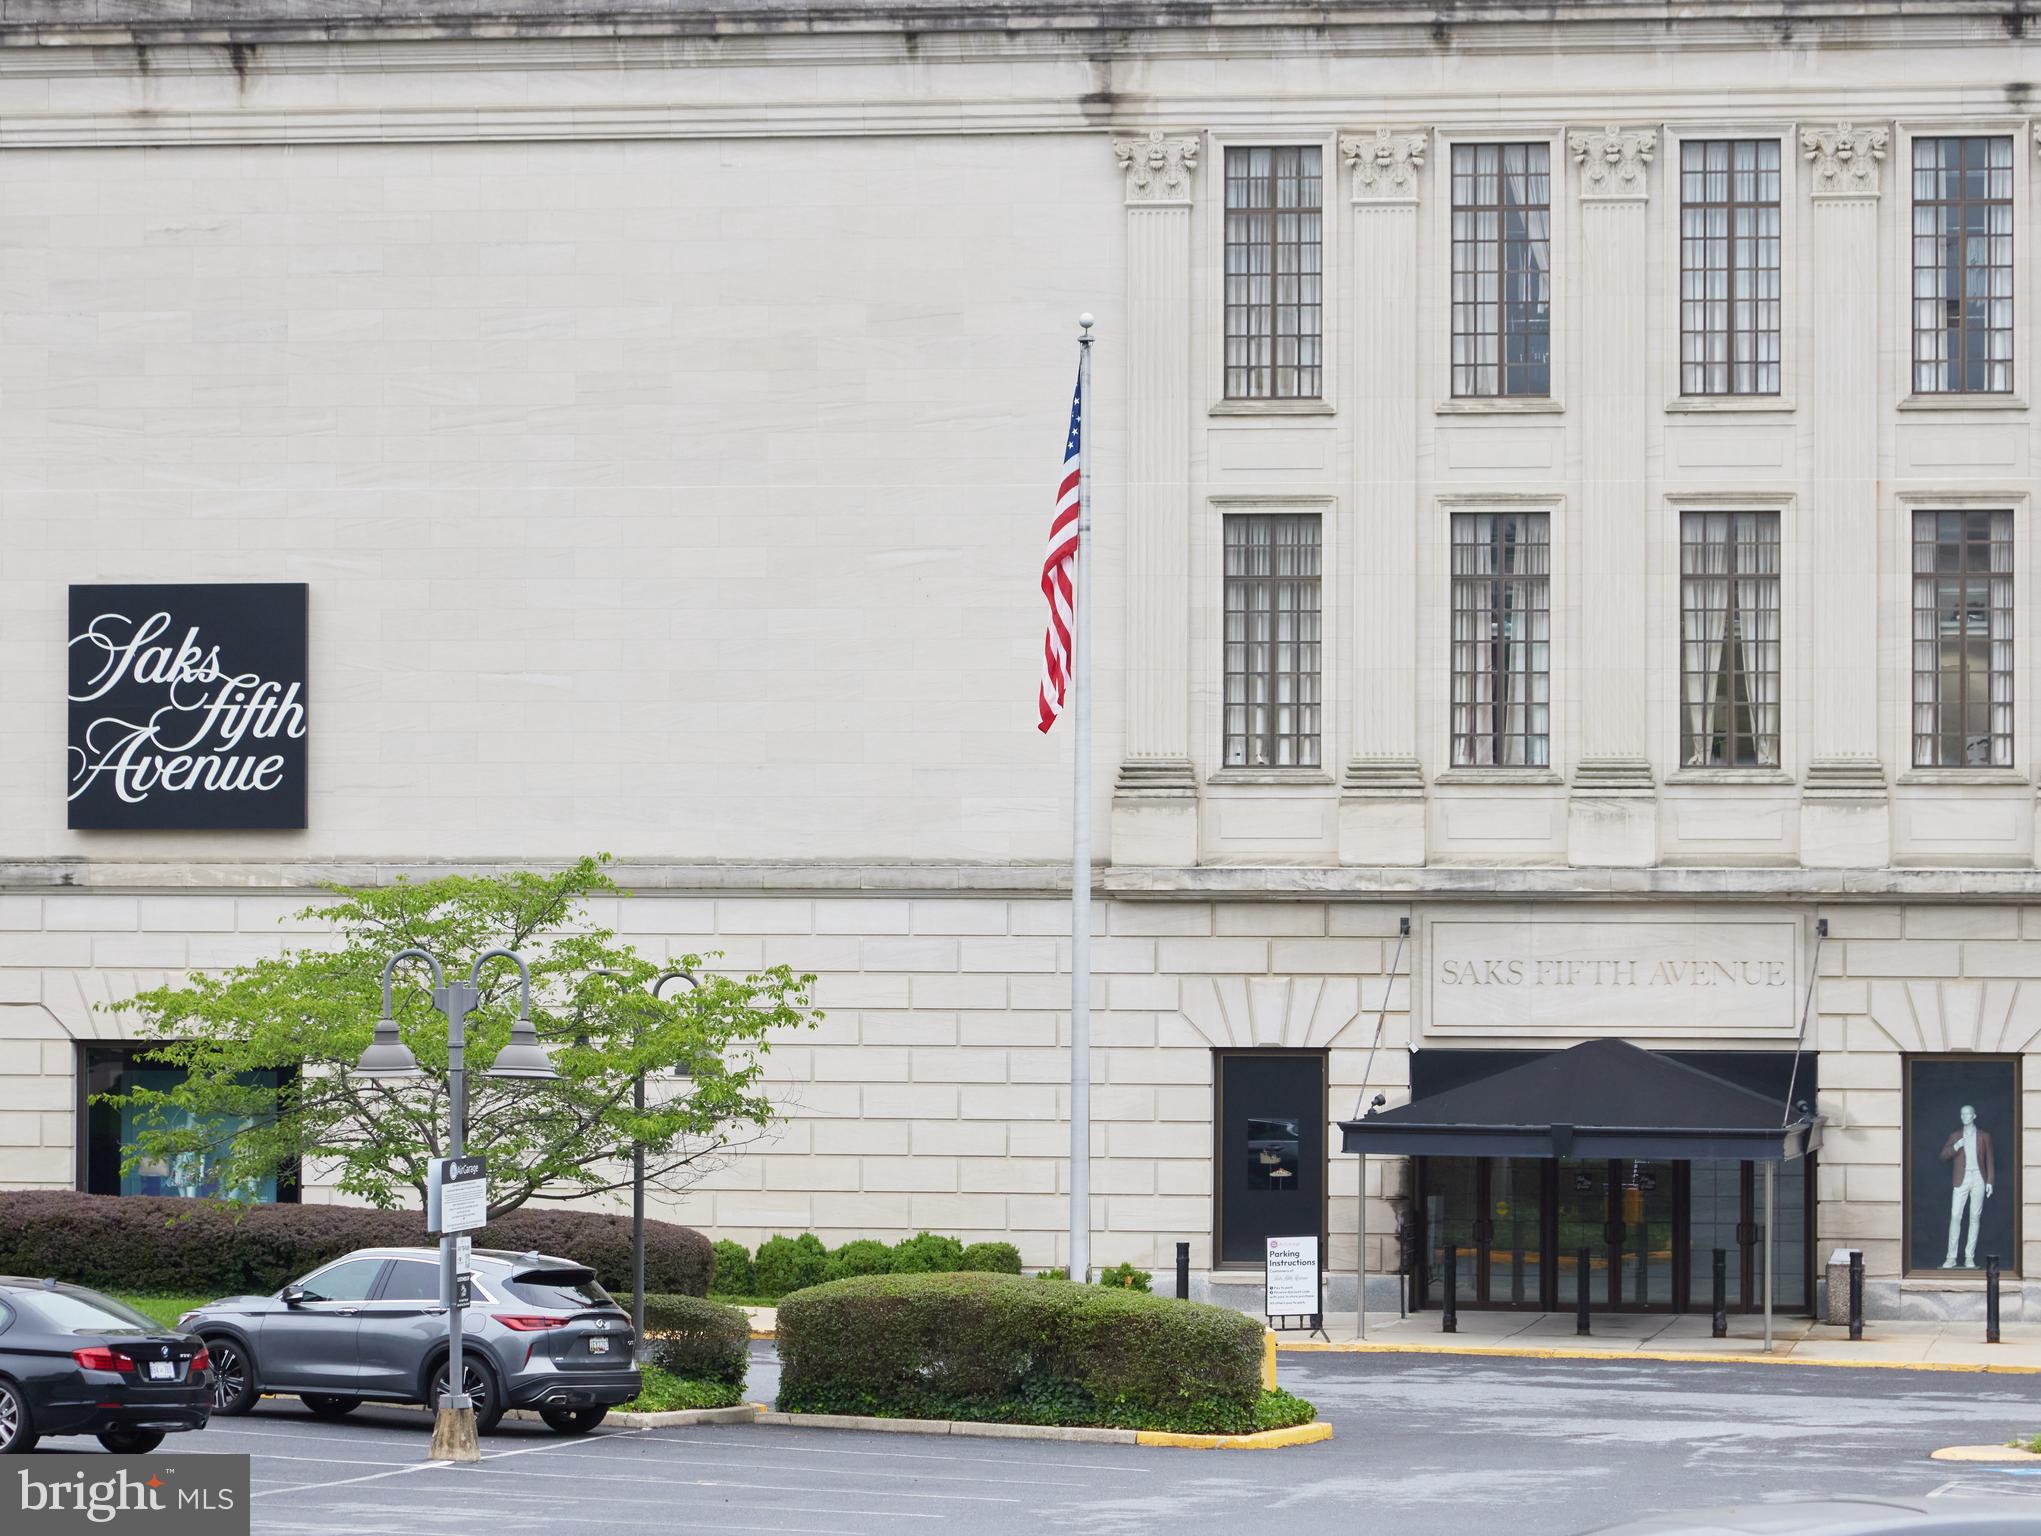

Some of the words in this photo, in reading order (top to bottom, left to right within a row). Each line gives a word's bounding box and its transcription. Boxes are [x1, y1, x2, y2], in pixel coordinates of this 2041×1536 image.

[68, 611, 220, 702] Saks
[150, 669, 306, 752] Fifth
[68, 717, 284, 803] Avenue
[1441, 959, 1524, 986] SAKS
[1535, 960, 1638, 985] FIFTH
[1648, 960, 1787, 987] AVENUE
[457, 1164, 479, 1175] AirGarage
[1269, 1250, 1300, 1259] Parking
[1269, 1259, 1316, 1267] Instructions
